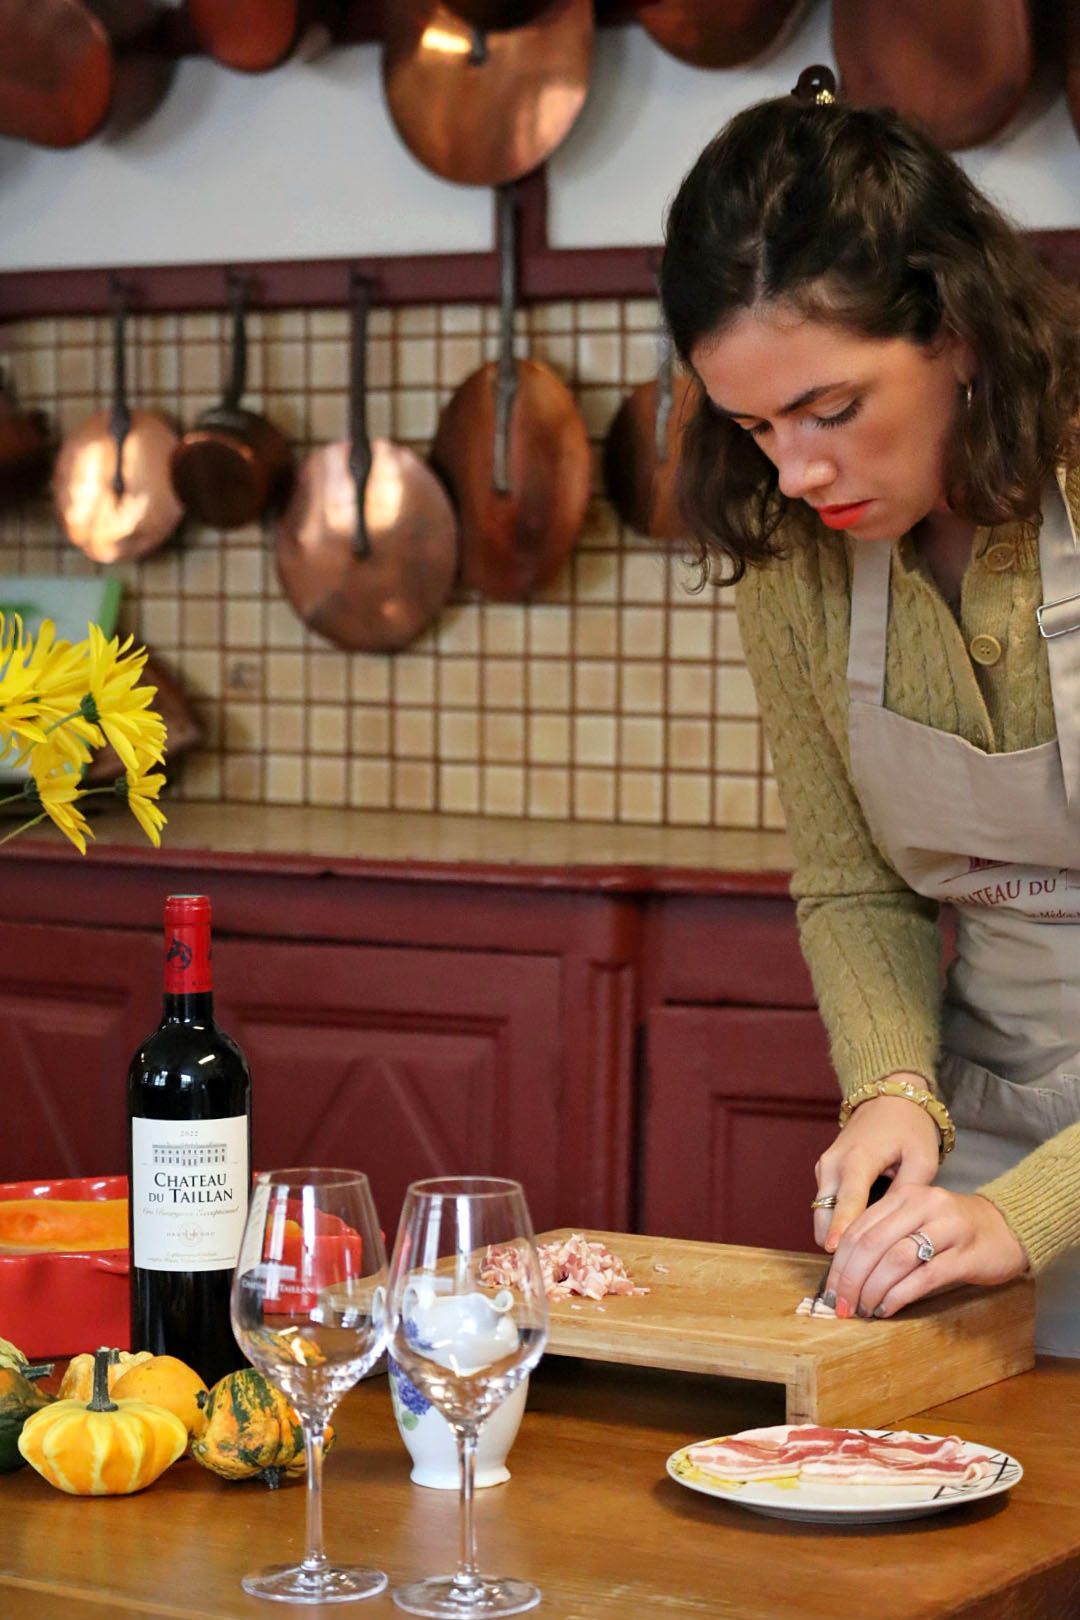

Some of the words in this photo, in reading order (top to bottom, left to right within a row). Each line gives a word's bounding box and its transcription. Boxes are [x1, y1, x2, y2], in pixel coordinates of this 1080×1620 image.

[1029, 879, 1057, 896] DU
[154, 1172, 227, 1188] CHATEAU
[168, 1188, 233, 1203] TAILLAN
